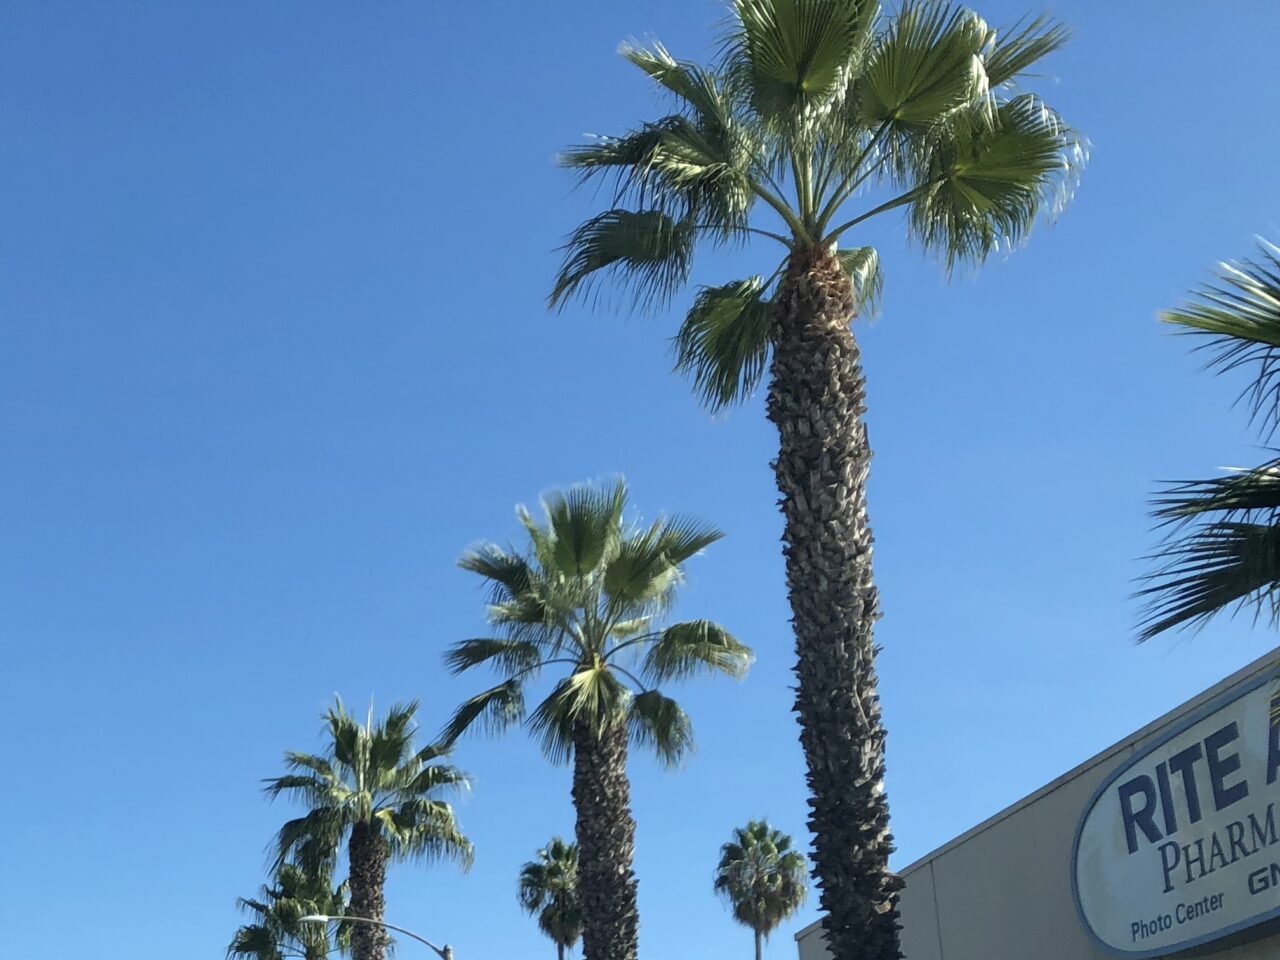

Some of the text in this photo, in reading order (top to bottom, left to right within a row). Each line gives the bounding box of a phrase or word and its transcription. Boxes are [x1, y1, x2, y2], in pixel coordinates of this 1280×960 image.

[1118, 720, 1249, 855] RITE
[1158, 803, 1279, 893] PHARM
[1131, 892, 1224, 942] Photo Center
